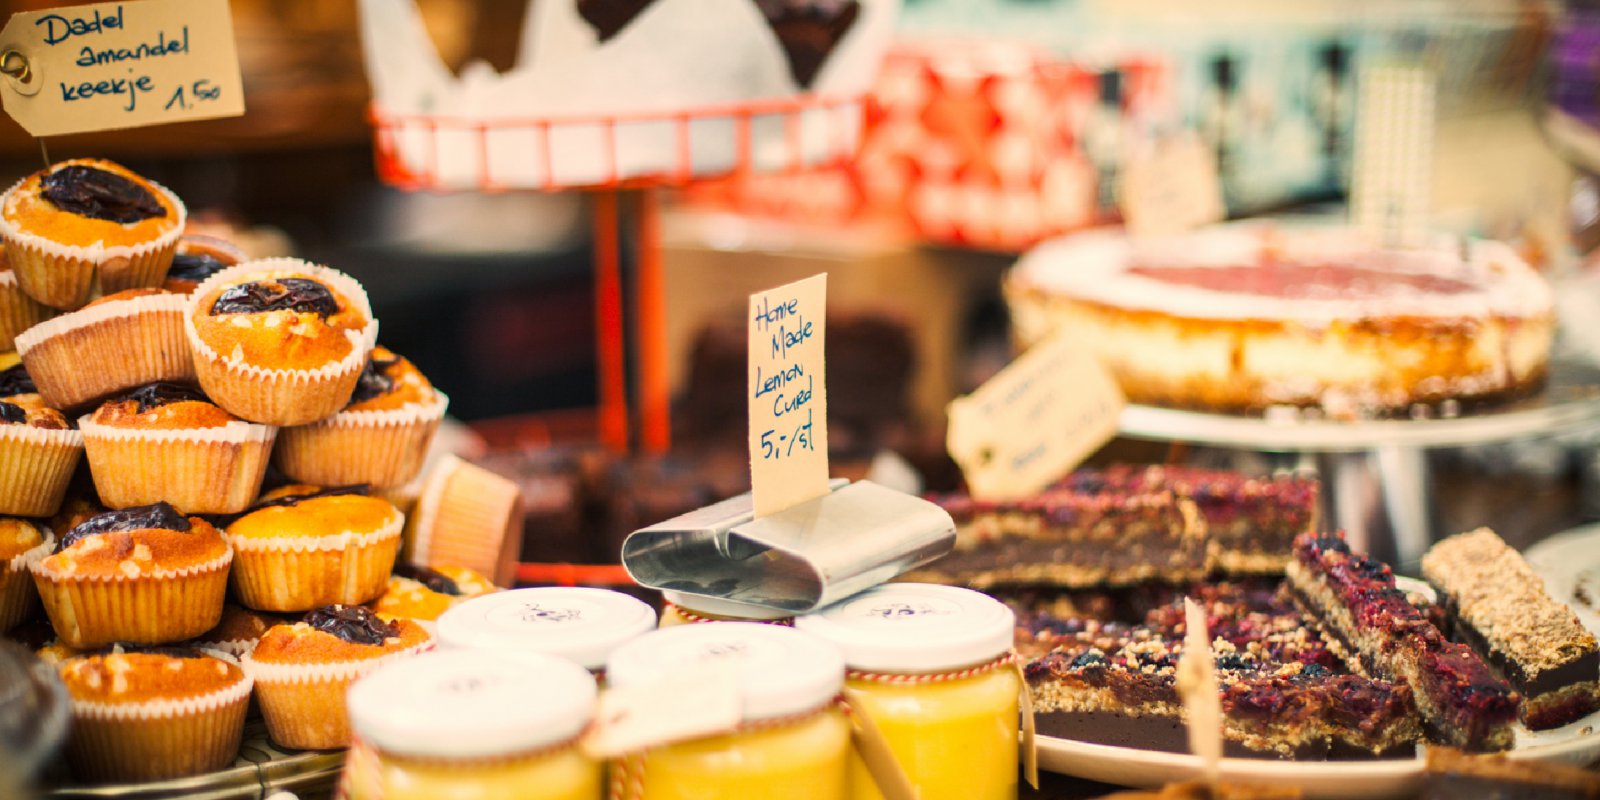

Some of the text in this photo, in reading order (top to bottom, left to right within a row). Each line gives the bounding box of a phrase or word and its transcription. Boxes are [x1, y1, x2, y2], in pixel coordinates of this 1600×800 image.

[35, 5, 123, 46] Dadel
[75, 25, 189, 67] amandel
[60, 69, 154, 112] keekje
[755, 297, 798, 332] Home
[771, 314, 812, 360] Made
